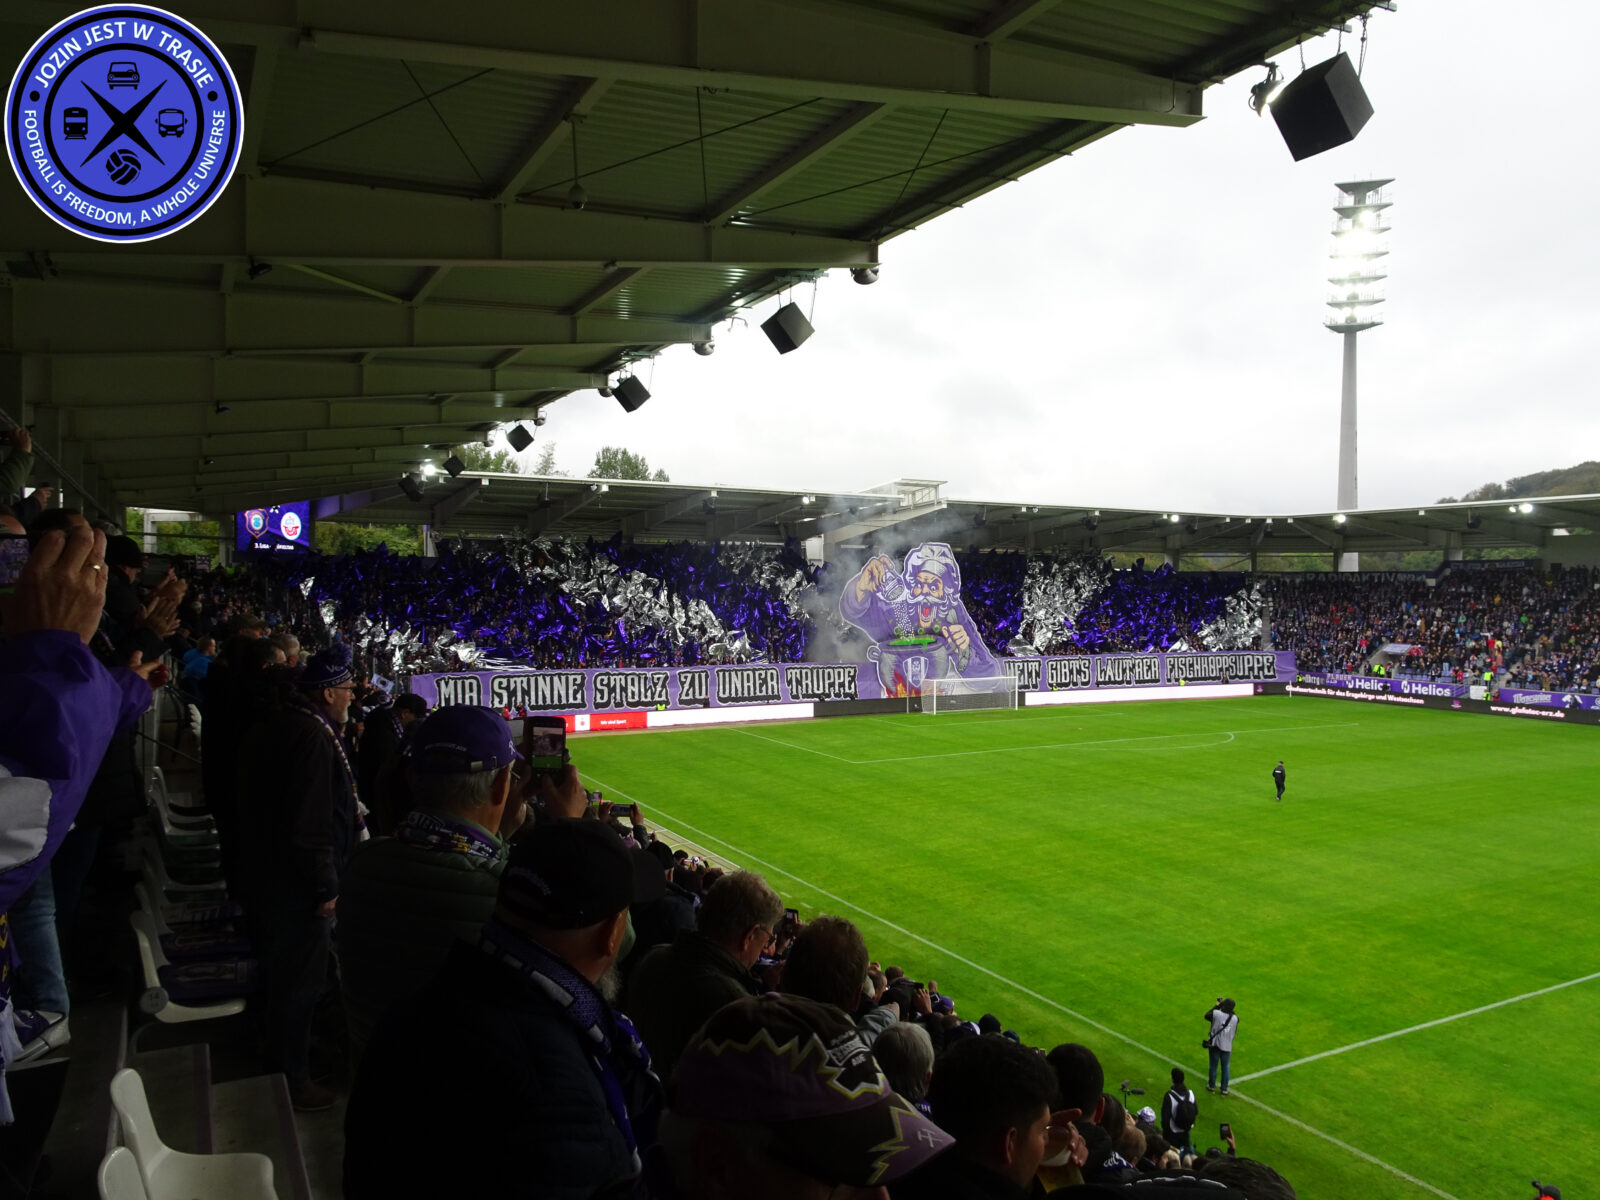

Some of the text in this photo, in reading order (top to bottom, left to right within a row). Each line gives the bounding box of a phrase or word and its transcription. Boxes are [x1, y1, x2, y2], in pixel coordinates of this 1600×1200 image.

[1048, 657, 1090, 686] GIBT'S
[594, 672, 668, 706] STOLZ
[678, 671, 709, 704] ZU
[786, 666, 857, 698] TRUPPE
[1412, 684, 1451, 696] Helios
[1376, 693, 1387, 701] und
